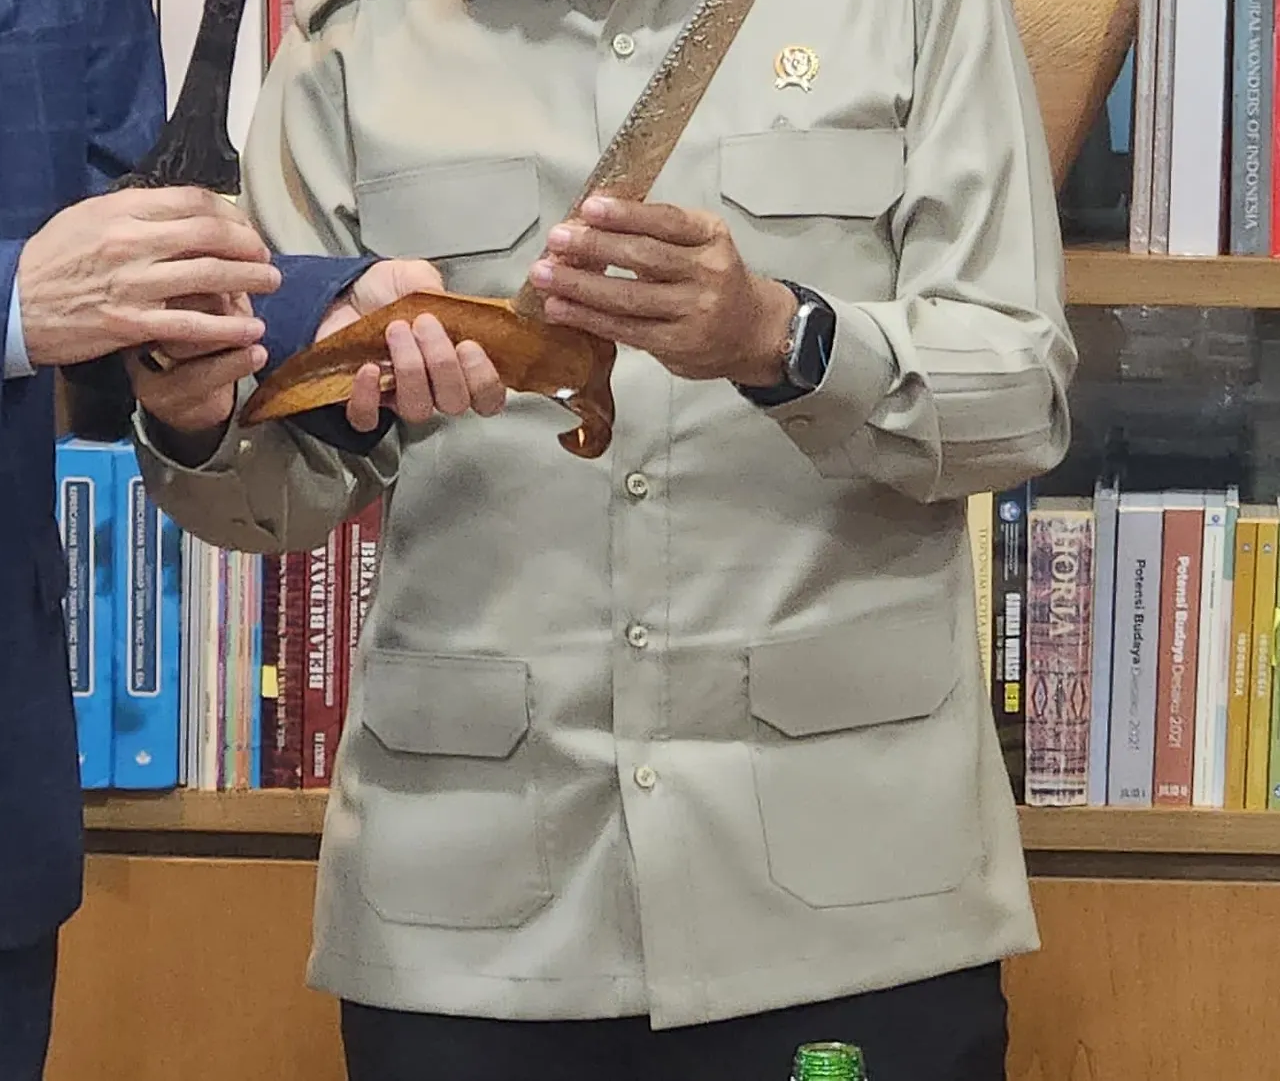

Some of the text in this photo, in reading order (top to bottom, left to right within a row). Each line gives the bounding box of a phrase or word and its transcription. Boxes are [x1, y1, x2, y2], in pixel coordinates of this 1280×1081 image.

[1246, 38, 1262, 116] WONDERS
[1245, 119, 1261, 142] OF
[1244, 145, 1261, 230] INDONESIA
[1049, 534, 1079, 638] HORJA
[1133, 559, 1146, 610] Potensi
[1175, 555, 1190, 609] Potensi
[308, 546, 326, 690] BELA BUDAYA
[1130, 613, 1145, 664] Budaya
[1171, 610, 1189, 664] Budaya
[1168, 715, 1182, 748] 2021
